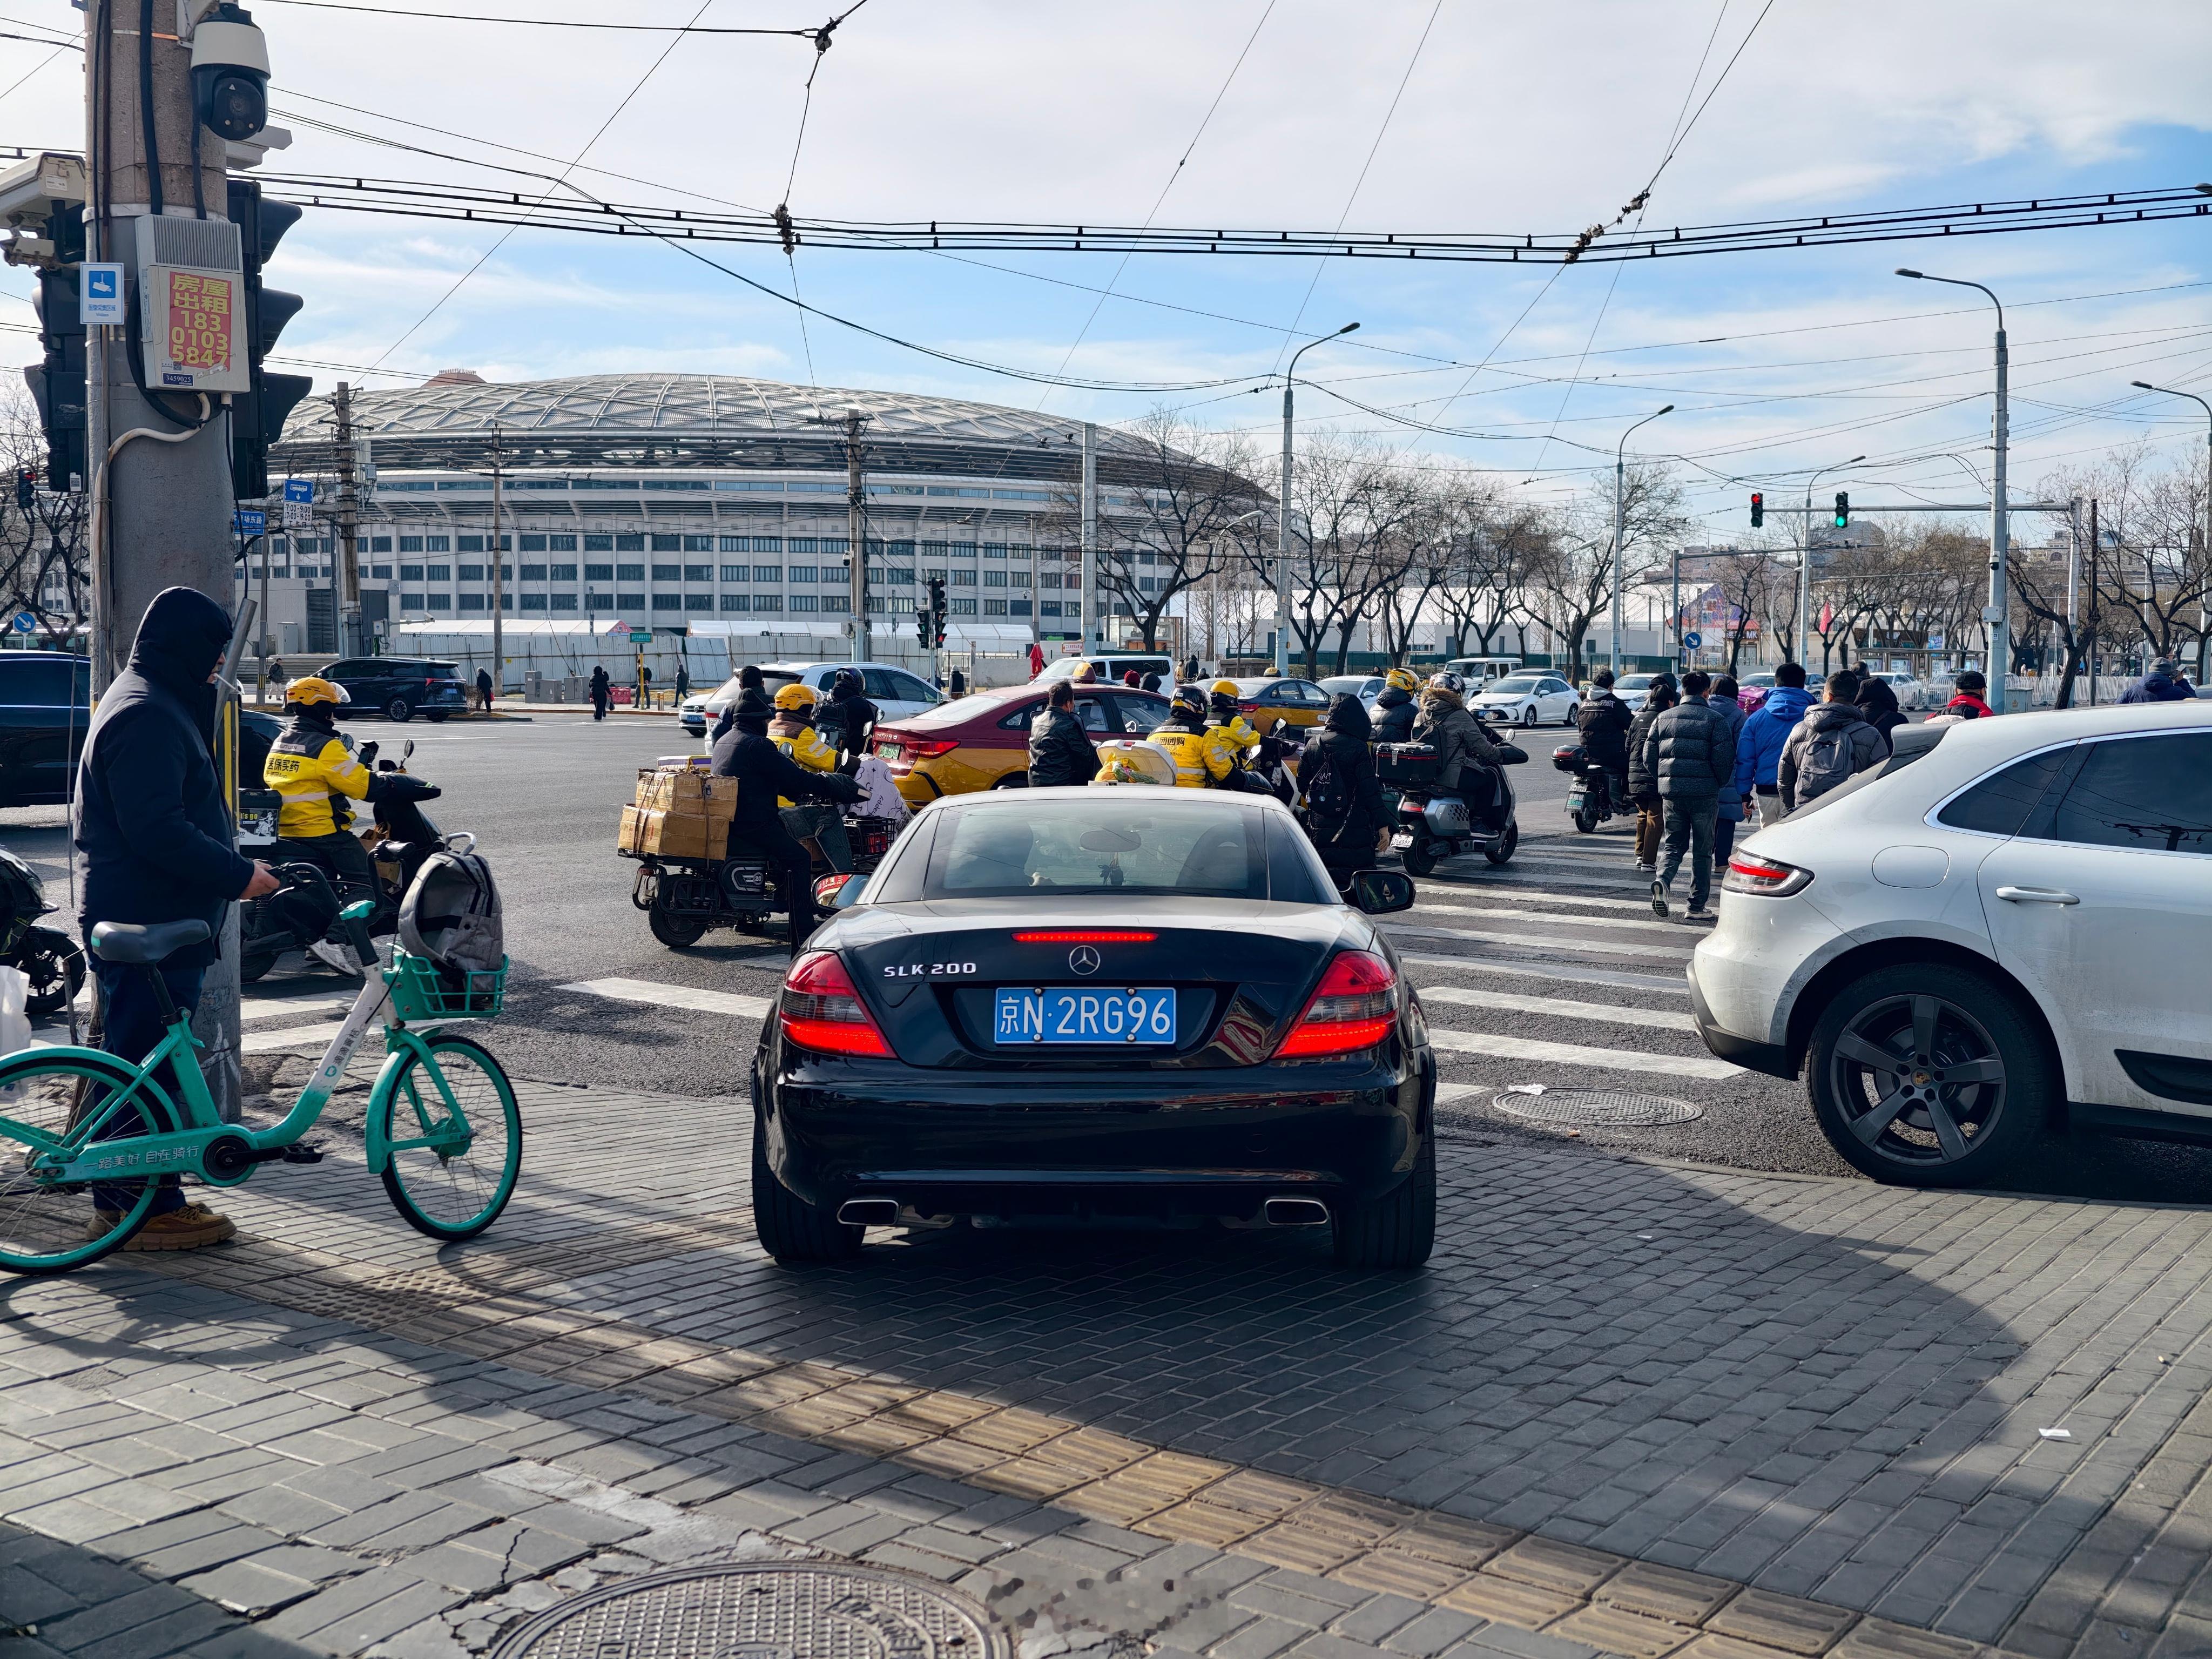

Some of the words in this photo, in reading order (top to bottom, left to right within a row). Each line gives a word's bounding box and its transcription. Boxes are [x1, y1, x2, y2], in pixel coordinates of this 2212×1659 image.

[172, 274, 229, 298] 房屋
[173, 292, 230, 315] 出租
[180, 310, 221, 332] 183
[171, 326, 228, 350] 0103
[172, 345, 228, 366] 5847
[166, 375, 191, 383] 3459025
[267, 758, 300, 773] 医保买药
[884, 965, 925, 977] SLK
[930, 962, 976, 975] 200
[1000, 996, 1171, 1034] 京N·2RG96
[84, 1153, 140, 1170] 一路美好
[145, 1145, 199, 1163] 自在骑行
